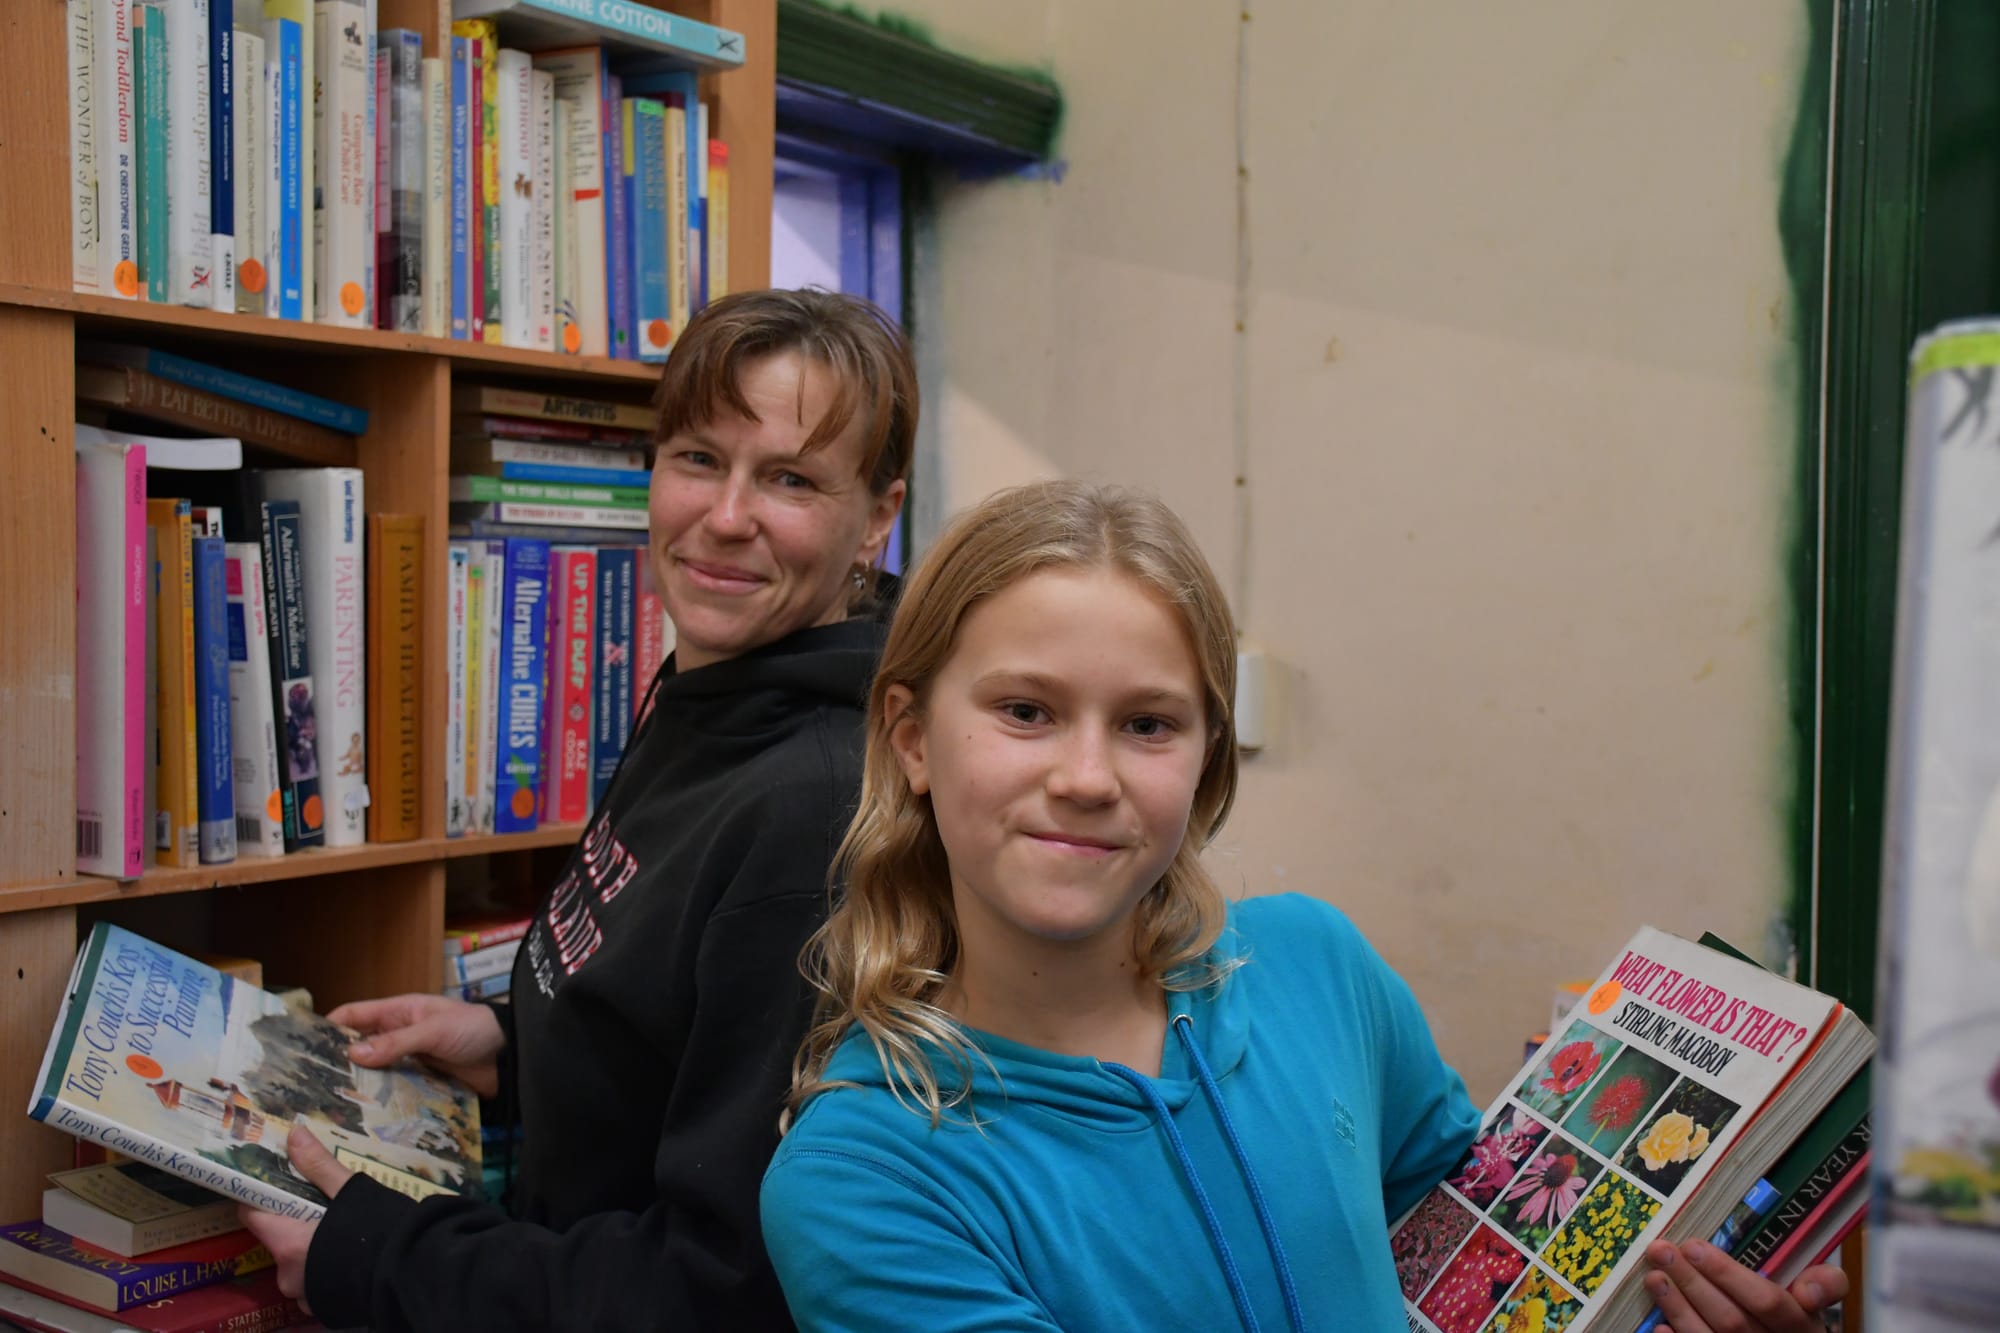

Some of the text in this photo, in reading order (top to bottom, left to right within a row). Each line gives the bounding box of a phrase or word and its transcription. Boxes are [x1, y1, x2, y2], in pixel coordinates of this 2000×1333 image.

[75, 13, 90, 54] THE
[600, 3, 671, 37] COTTON
[112, 0, 131, 143] yond Toddlerdom
[221, 32, 230, 94] sleep sense
[77, 64, 91, 164] WONDER
[193, 60, 209, 152] Archetype
[456, 105, 466, 145] When
[519, 66, 529, 160] WILDHOOD
[197, 159, 211, 196] Diet
[453, 149, 465, 178] your
[456, 183, 466, 219] child
[543, 82, 552, 316] NEVER TELL ME NEVER
[79, 195, 93, 250] BOYS
[119, 154, 131, 261] DR CHRISTOPHER GREEN
[160, 384, 190, 413] EAT
[261, 502, 280, 638] LIFE BEYOND DEATH
[280, 526, 301, 671] Alternative Medicine
[255, 610, 266, 637] girls
[336, 556, 354, 709] PARENTING
[511, 576, 542, 680] Alternative
[571, 563, 588, 690] UP THE DUFF
[400, 544, 415, 831] FAMILY HEALTH GUIDE
[509, 683, 538, 749] CURES
[565, 729, 577, 780] COOKE
[576, 739, 588, 771] KAZ
[66, 943, 141, 1102] Tony Couch's Keys
[125, 946, 179, 1055] to Successful
[162, 967, 213, 1039] Painting
[1609, 950, 1667, 1001] WHAT
[1655, 969, 1727, 1027] FLOWER
[1710, 997, 1748, 1035] IS
[1613, 1001, 1738, 1077] STIRLING MACOBOY
[56, 1106, 98, 1138] Tony
[100, 1126, 165, 1163] Couch's
[163, 1152, 206, 1184] Keys
[206, 1170, 224, 1188] to
[226, 1176, 309, 1221] Successful
[1736, 1145, 1858, 1270] YEAR IN THE
[123, 1271, 179, 1304] LOUISE
[196, 1259, 229, 1282] HAY
[227, 1303, 284, 1331] STATISTICS
